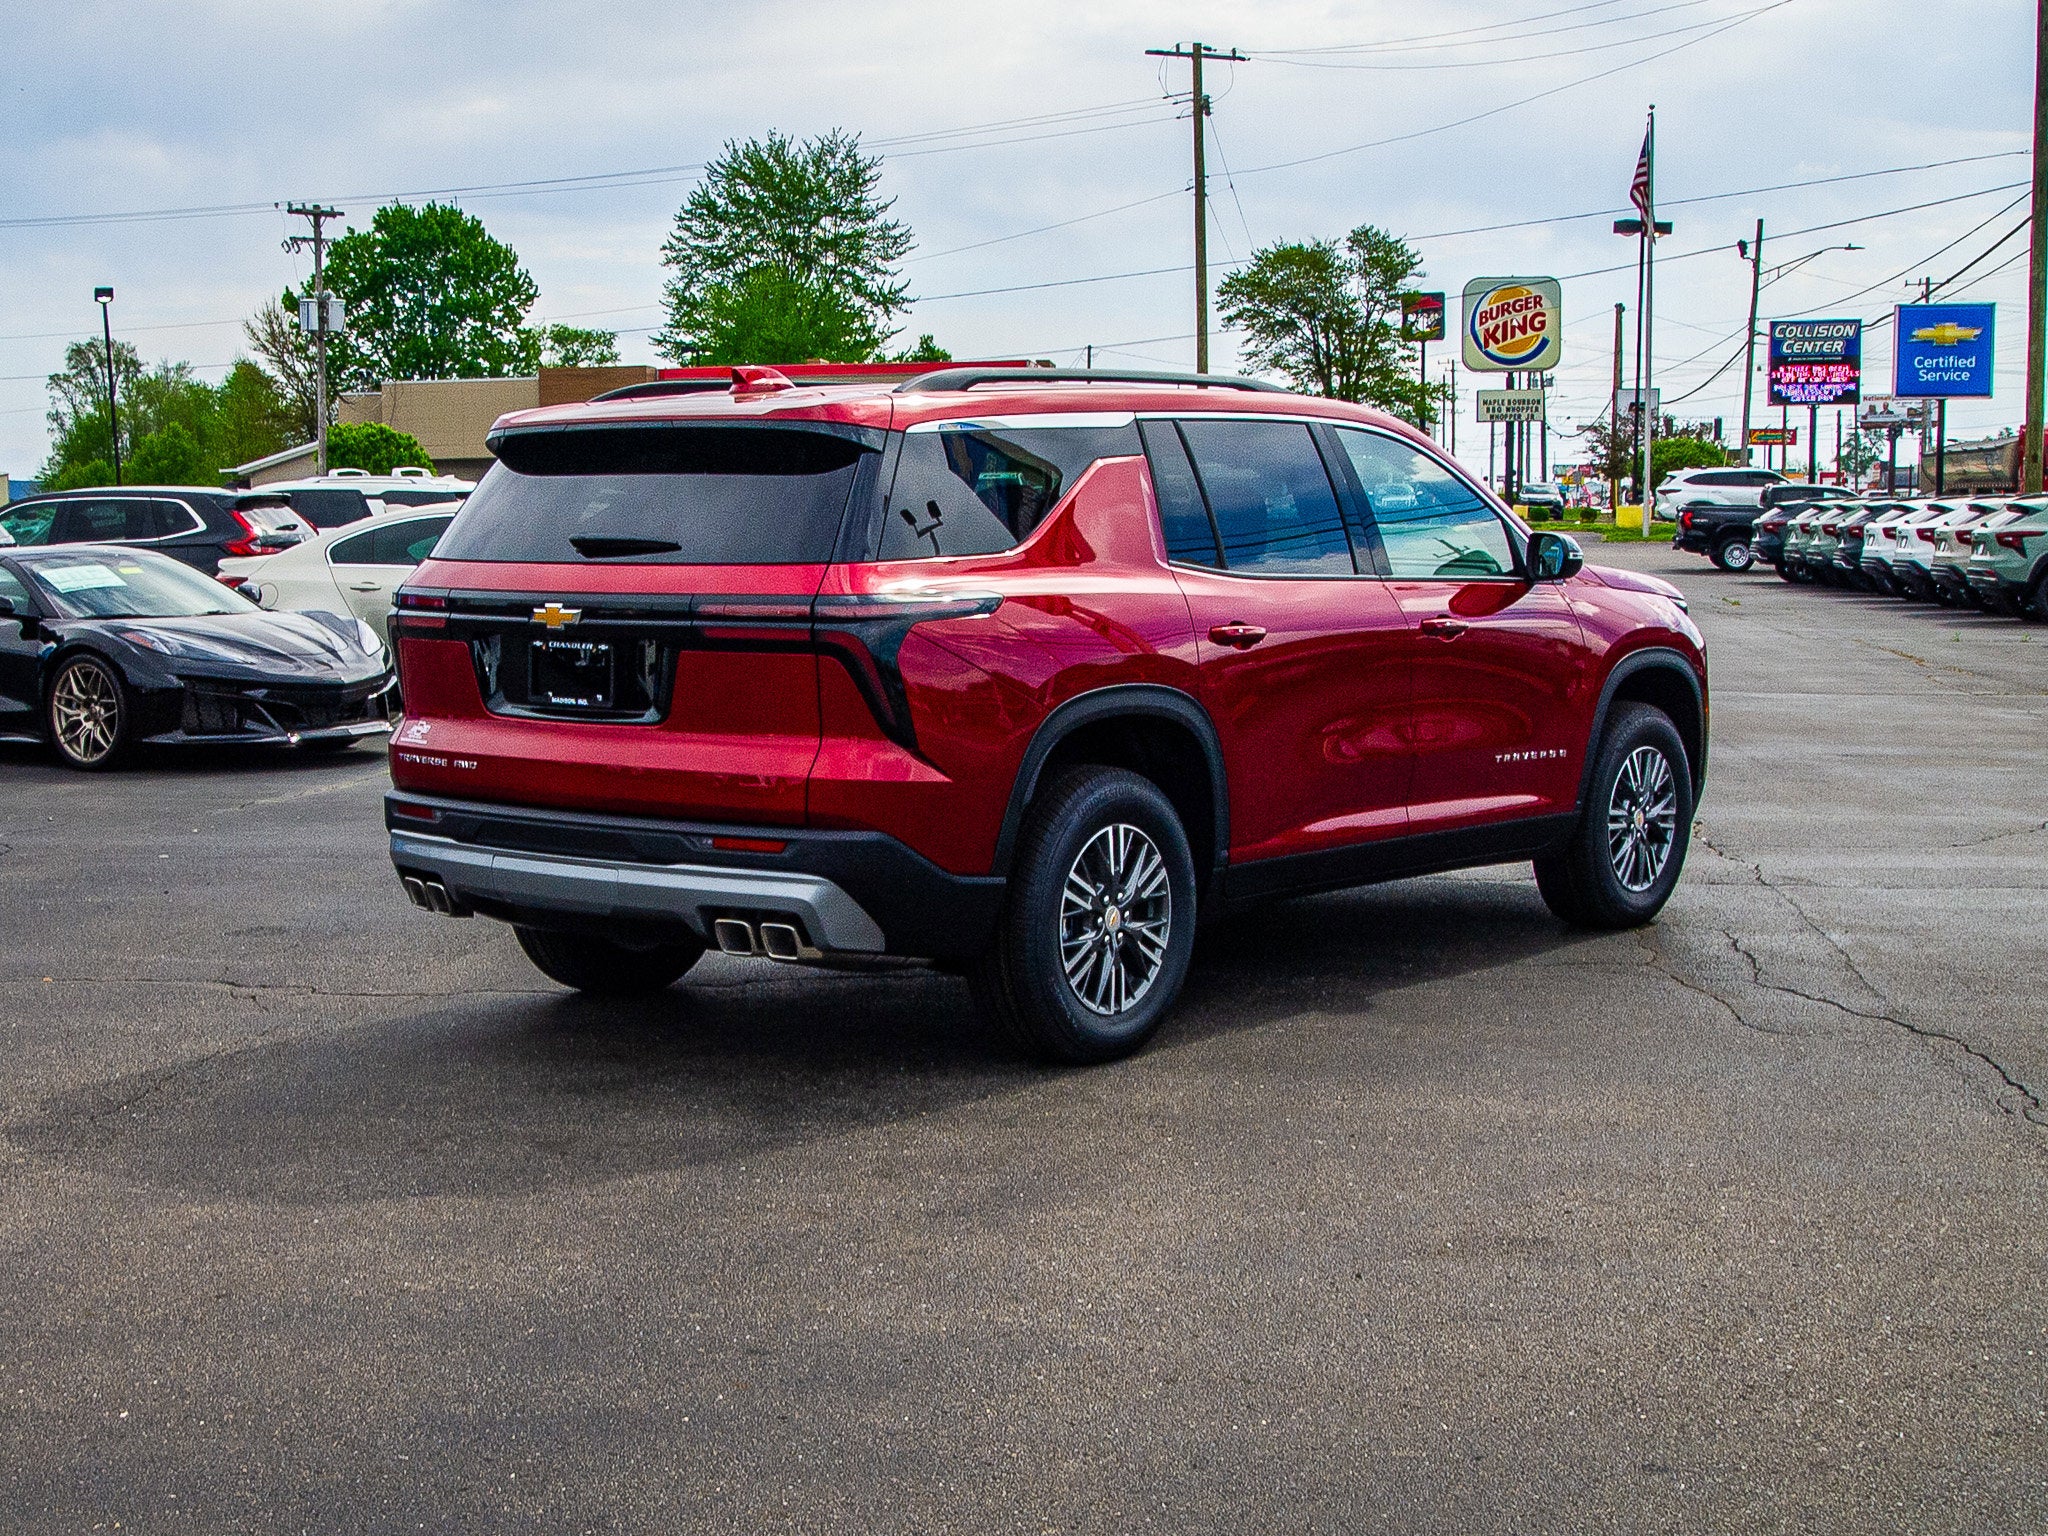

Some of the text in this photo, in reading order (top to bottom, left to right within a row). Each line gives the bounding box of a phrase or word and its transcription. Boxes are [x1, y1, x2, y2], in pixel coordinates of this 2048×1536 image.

[1479, 295, 1543, 327] BURGER
[1483, 312, 1546, 349] KING
[1775, 324, 1855, 338] COLLISION
[1782, 340, 1844, 353] CENTER
[1914, 356, 1976, 368] Certified
[1919, 369, 1970, 381] Service
[548, 641, 594, 650] CHANDLER
[399, 752, 478, 770] TRAVERSE AWD
[1495, 749, 1567, 763] TRAVERSE
